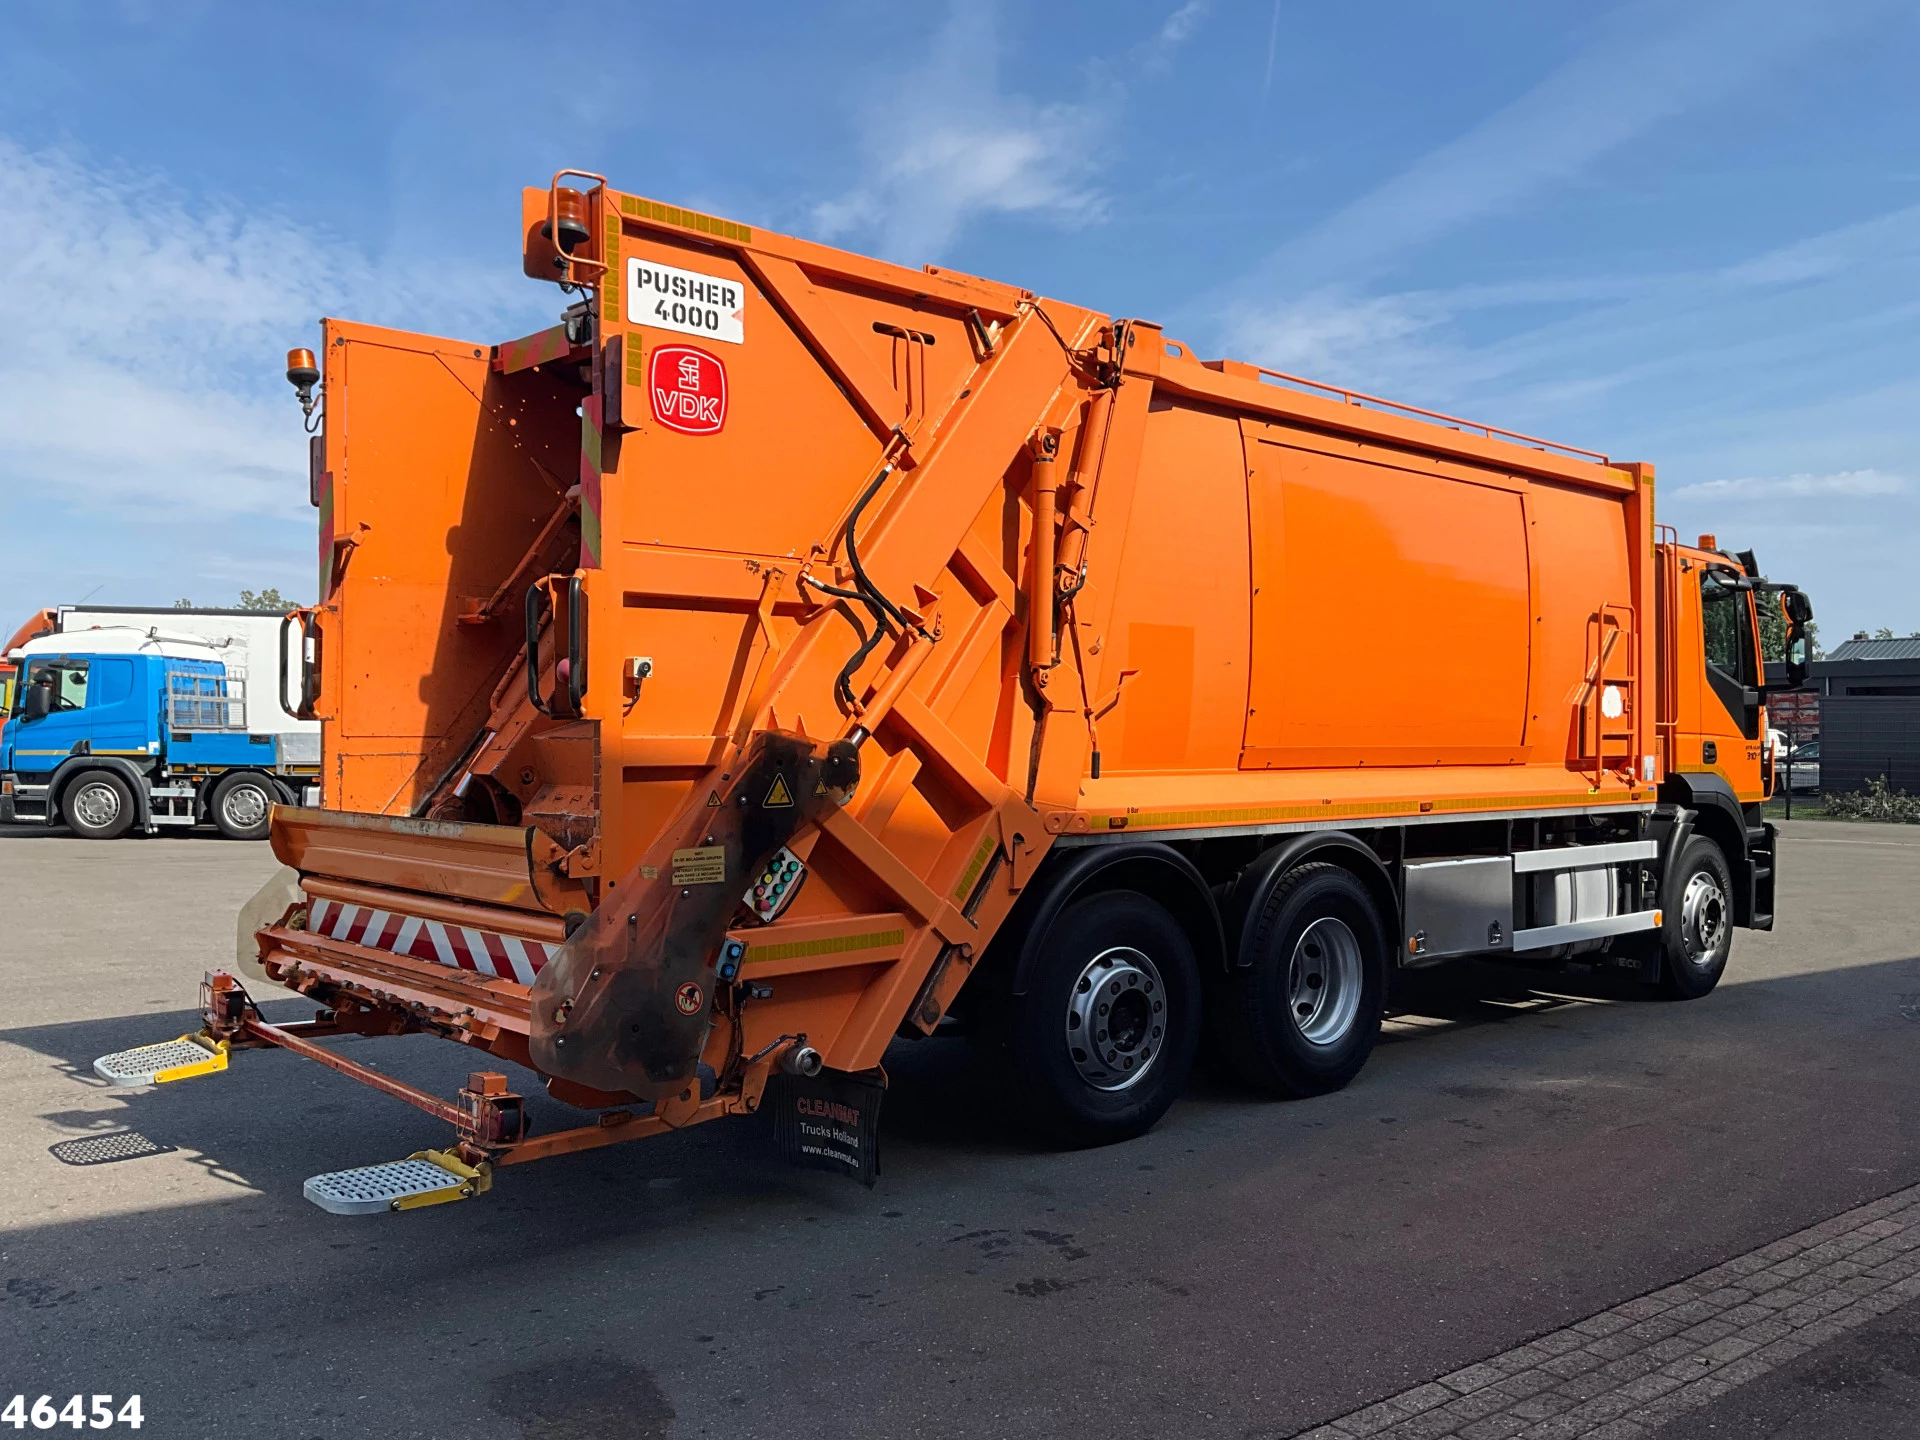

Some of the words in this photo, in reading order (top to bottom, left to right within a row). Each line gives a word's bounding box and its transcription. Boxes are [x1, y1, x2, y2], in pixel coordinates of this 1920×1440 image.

[637, 267, 736, 309] PUSHER
[654, 299, 719, 331] 4000
[656, 387, 719, 423] VDK
[800, 1122, 831, 1138] Trucks
[833, 1127, 859, 1148] Holland
